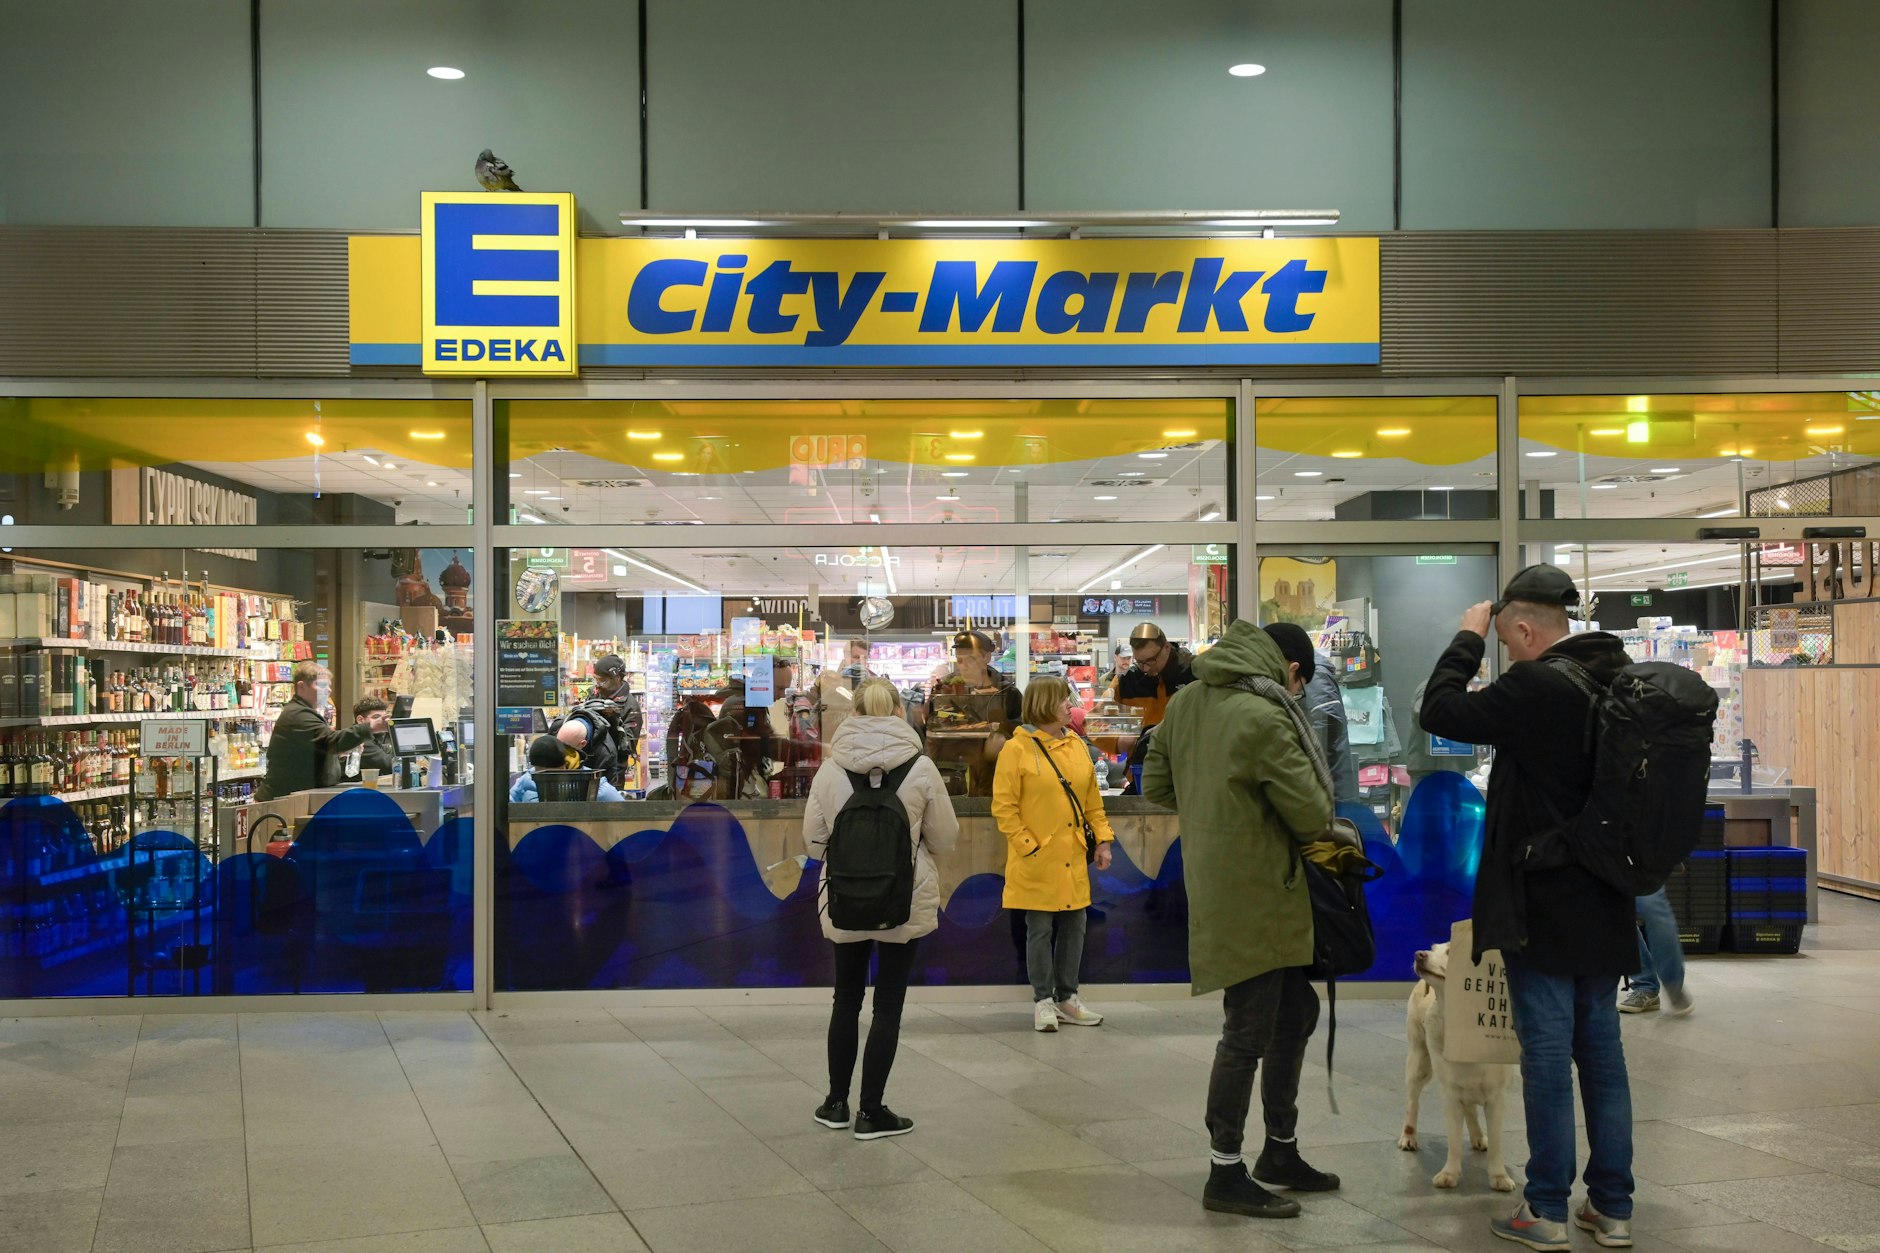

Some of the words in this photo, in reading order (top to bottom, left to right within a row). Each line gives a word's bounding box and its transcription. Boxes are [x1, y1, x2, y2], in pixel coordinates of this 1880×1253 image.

[434, 203, 559, 326] E
[626, 254, 1328, 347] City-Markt
[435, 339, 565, 362] EDEKA
[934, 598, 1012, 628] LEERGUT
[500, 640, 512, 649] Wir
[513, 640, 538, 649] suchen
[1464, 978, 1506, 995] GEHT
[1478, 1013, 1515, 1030] KAT
